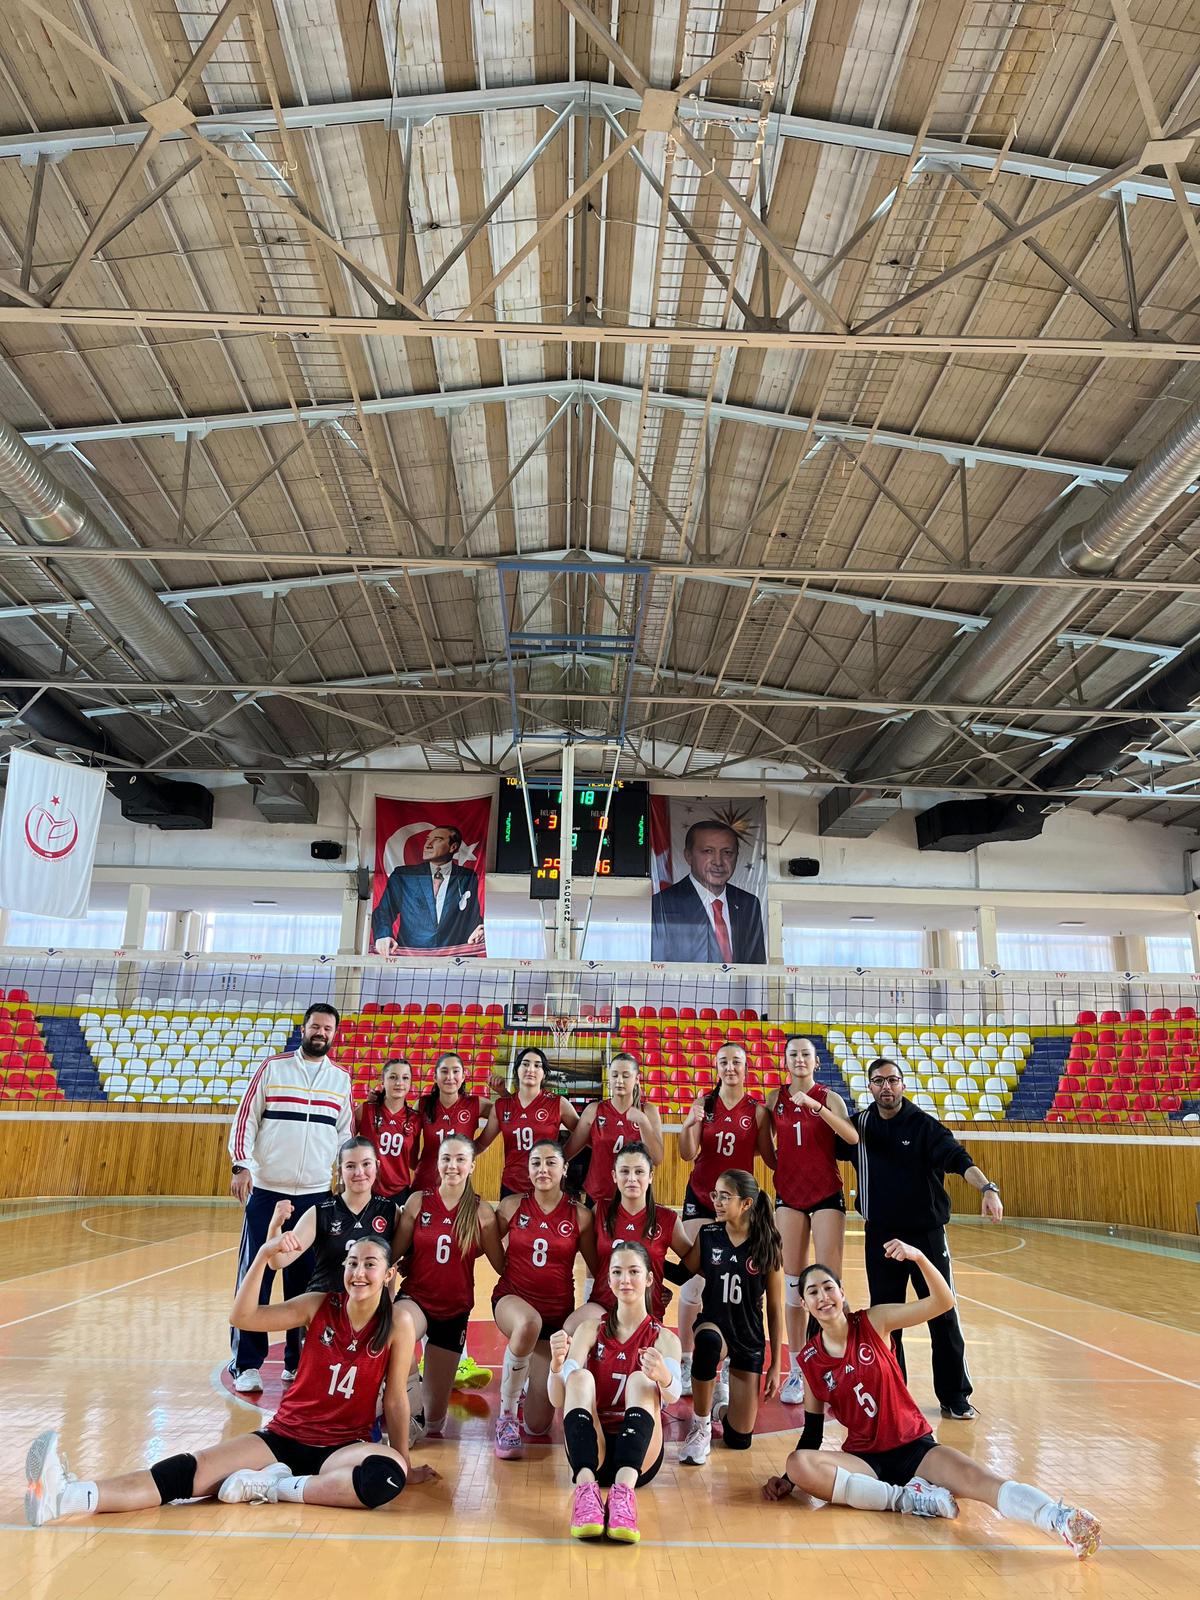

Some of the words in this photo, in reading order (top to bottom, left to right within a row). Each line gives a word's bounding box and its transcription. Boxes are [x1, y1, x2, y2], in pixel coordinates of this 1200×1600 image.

[580, 790, 595, 805] 18
[548, 815, 558, 829] 3
[379, 1131, 404, 1157] 99
[512, 1127, 534, 1151] 19
[715, 1131, 735, 1157] 13
[793, 1121, 802, 1146] 1
[435, 1234, 452, 1264] 6
[532, 1238, 548, 1267] 8
[720, 1272, 742, 1304] 16
[327, 1363, 358, 1400] 14
[611, 1373, 627, 1405] 7
[853, 1382, 878, 1418] 5
